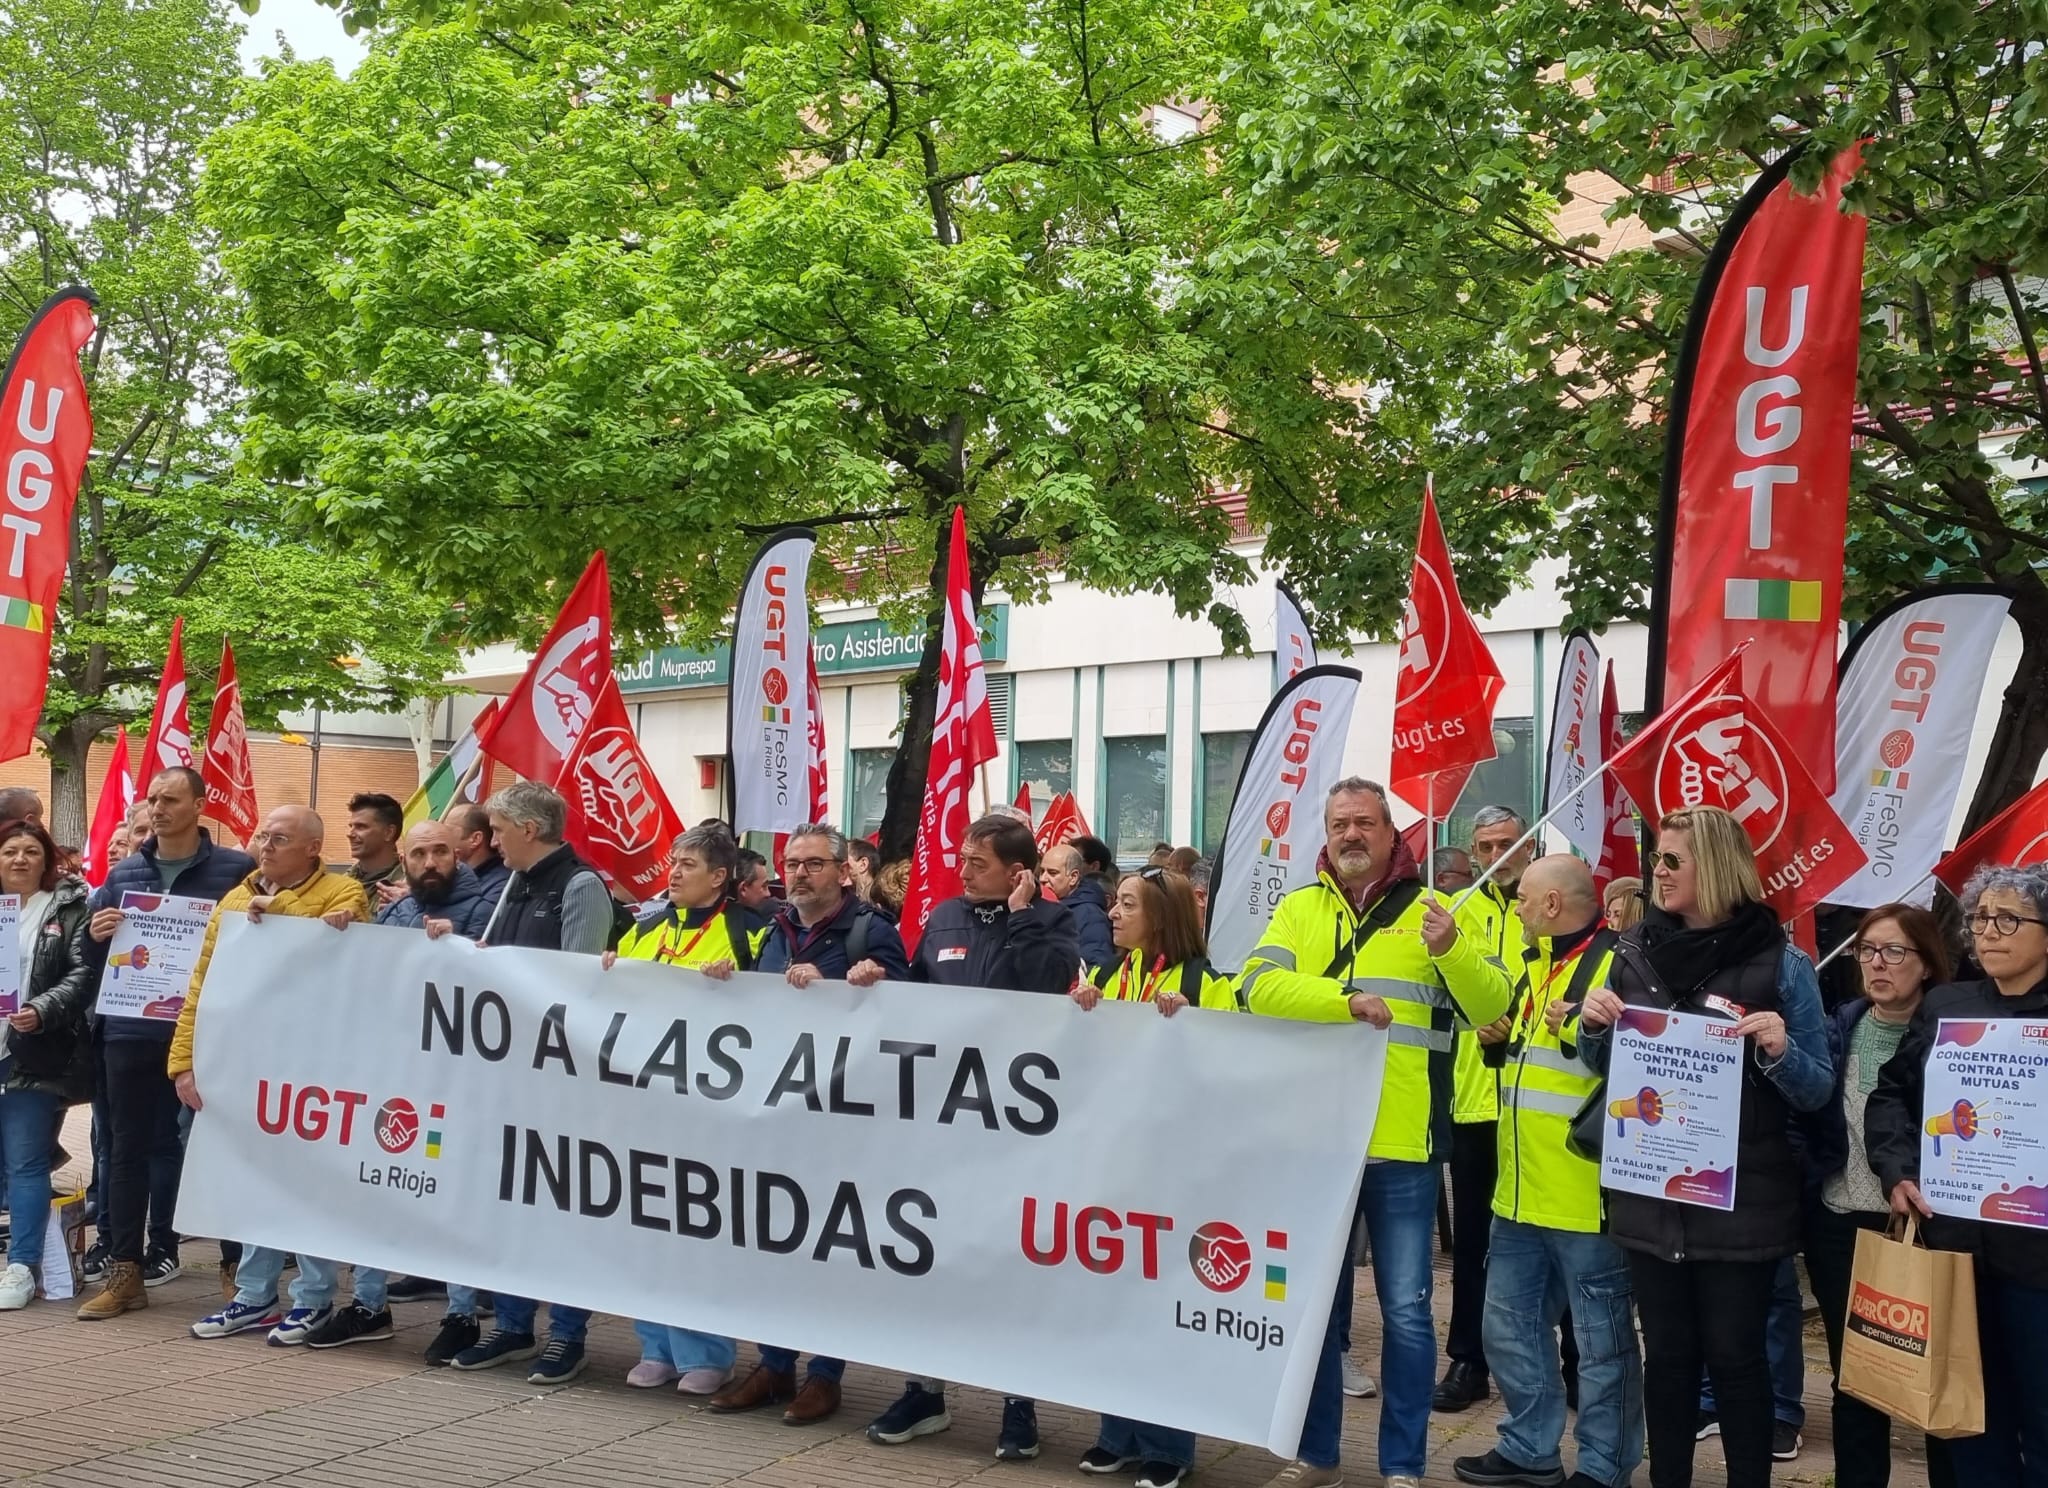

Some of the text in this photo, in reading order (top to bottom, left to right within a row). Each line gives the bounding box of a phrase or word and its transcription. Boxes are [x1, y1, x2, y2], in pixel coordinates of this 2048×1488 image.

[1733, 284, 1809, 550] UGT
[2, 378, 64, 579] UGT
[764, 566, 787, 661] UGT
[812, 642, 836, 664] tro
[660, 658, 716, 682] Muprespa
[1891, 621, 1945, 723] UGT
[1281, 699, 1322, 795] UGT
[775, 728, 789, 807] FeSMC
[1858, 791, 1881, 846] La Rioja
[1871, 793, 1904, 878] FeSMC
[1250, 880, 1261, 916] Rioja
[1266, 863, 1288, 922] FeS
[123, 912, 208, 928] CONCENTRACIÓN
[133, 922, 194, 935] CONTRA LAS
[918, 899, 931, 931] Ag
[141, 931, 183, 941] MUTUAS
[1706, 1025, 1728, 1037] UGT
[1720, 1038, 1737, 1046] FICA
[2023, 1026, 2045, 1037] UGT
[421, 981, 1061, 1137] NO A LAS ALTAS
[1620, 1037, 1736, 1064] CONCENTRACIÓN
[1633, 1052, 1719, 1074] CONTRA LAS
[1646, 1066, 1703, 1084] MUTUAS
[1948, 1063, 2036, 1078] CONTRA LAS
[1961, 1077, 2020, 1090] MUTUAS
[256, 1079, 368, 1146] UGT
[1611, 1167, 1661, 1183] DEFIENDE!
[1623, 1158, 1653, 1170] SALUD
[1656, 1165, 1668, 1173] SE
[359, 1162, 437, 1199] La Rioja
[1940, 1178, 1969, 1189] SALUD
[1971, 1183, 1984, 1191] SE
[499, 1125, 938, 1277] INDEBIDAS
[1930, 1190, 1976, 1203] DEFIENDE!
[1021, 1196, 1174, 1281] UGT
[1175, 1300, 1285, 1352] La Rioja
[1861, 1323, 1922, 1352] supermercados
